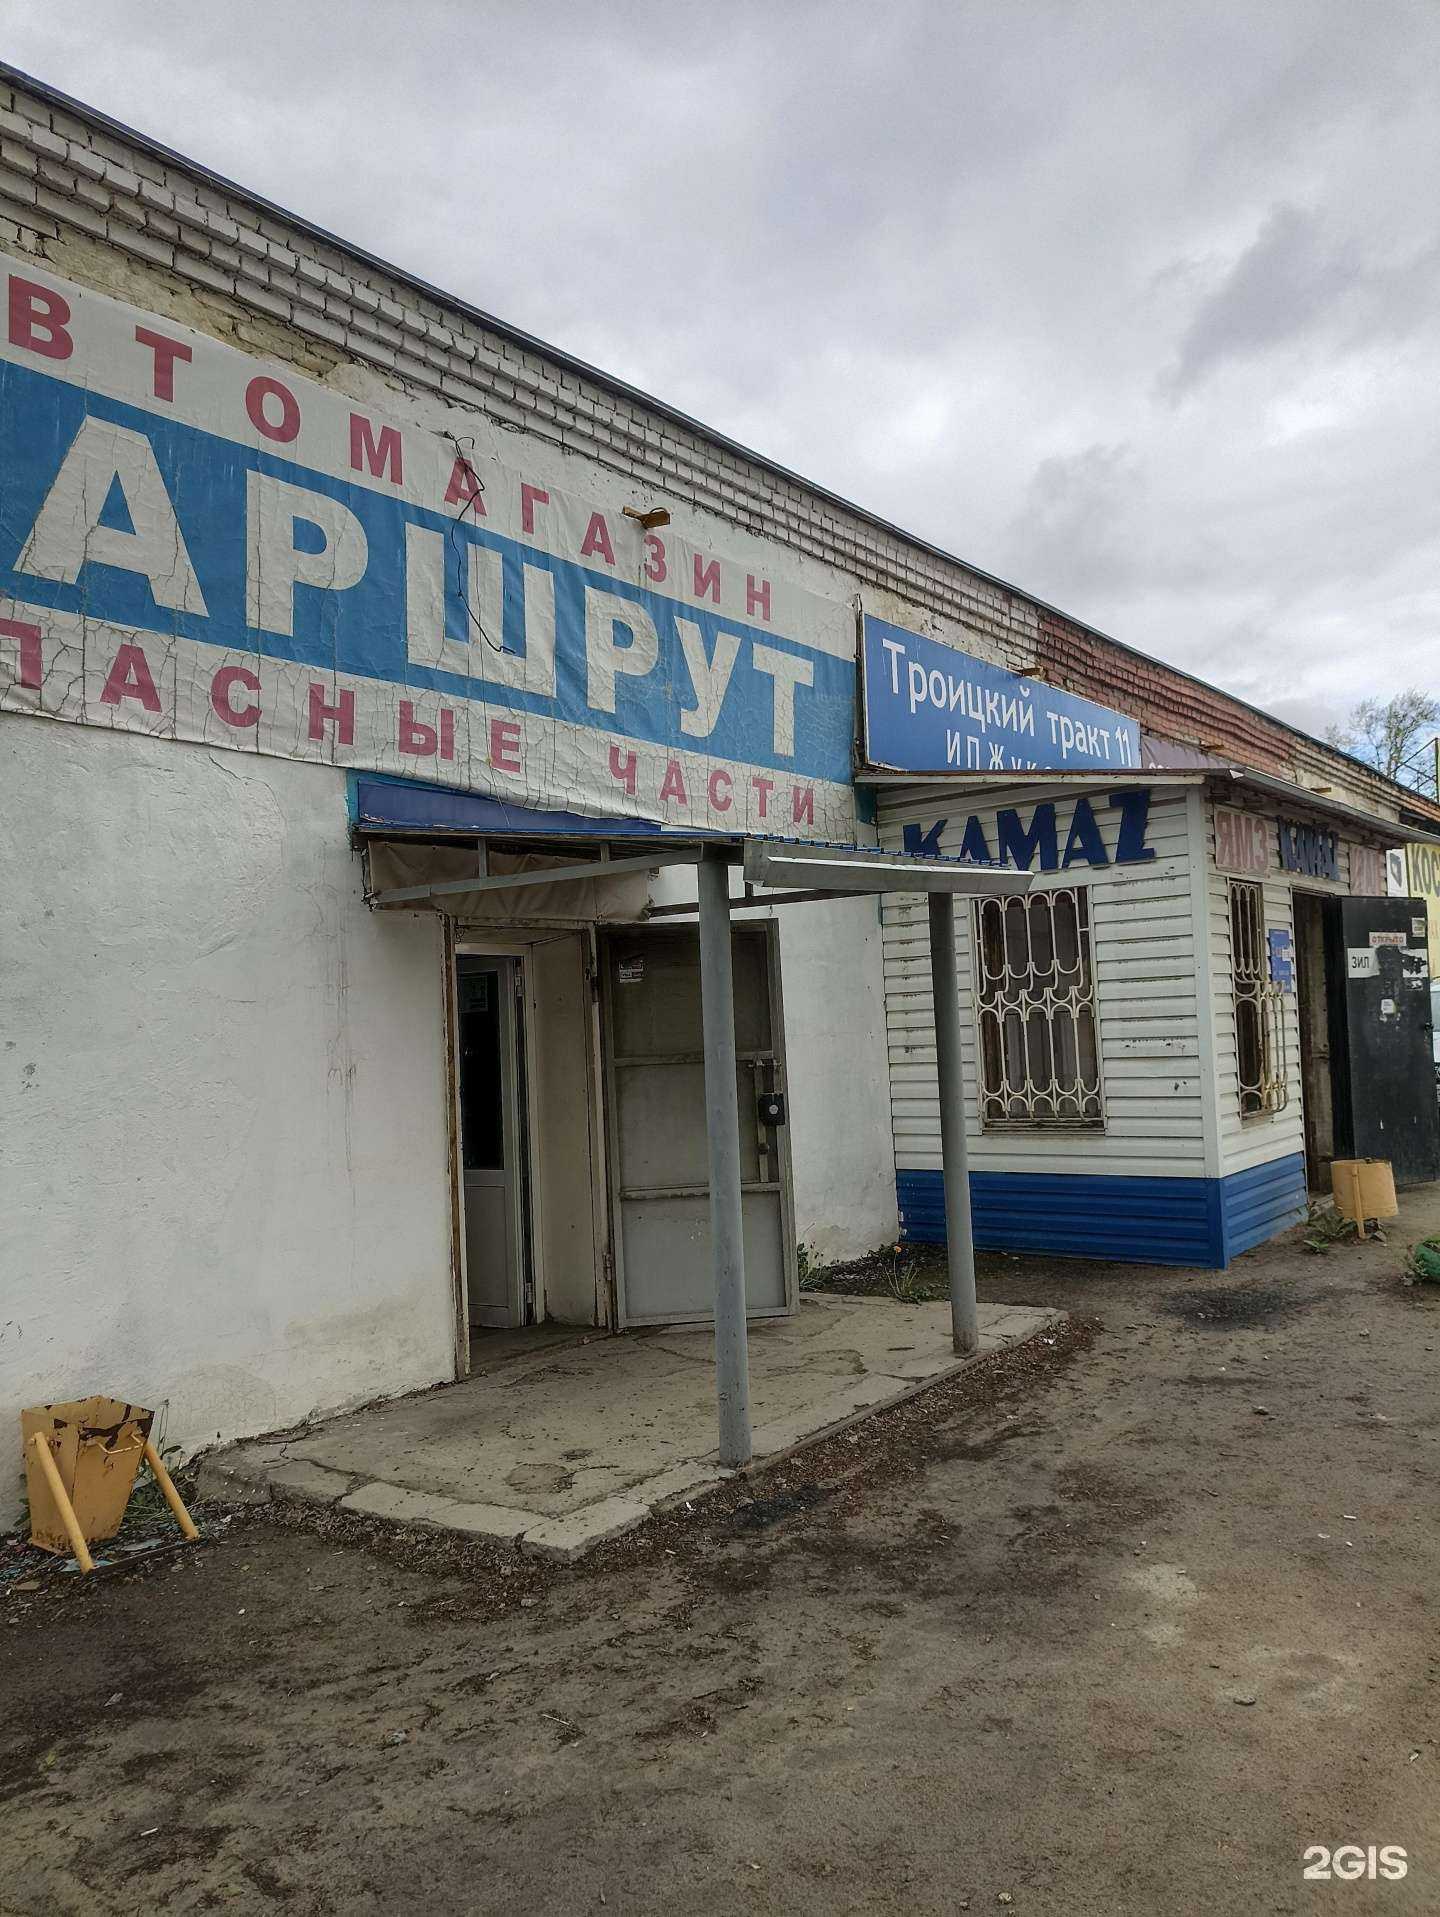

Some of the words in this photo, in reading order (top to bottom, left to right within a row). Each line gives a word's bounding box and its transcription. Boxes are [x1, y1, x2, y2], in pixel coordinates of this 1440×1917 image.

[9, 273, 770, 621] ВТОМАГАЗИН
[12, 414, 814, 757] АРШРУТ
[883, 639, 1035, 736] Троицкий
[1047, 711, 1110, 760] тракт
[1114, 726, 1133, 767] 11
[609, 746, 814, 826] ЧАСТИ
[903, 788, 1155, 871] KAMAZ
[1352, 957, 1370, 969] ЗИЛ
